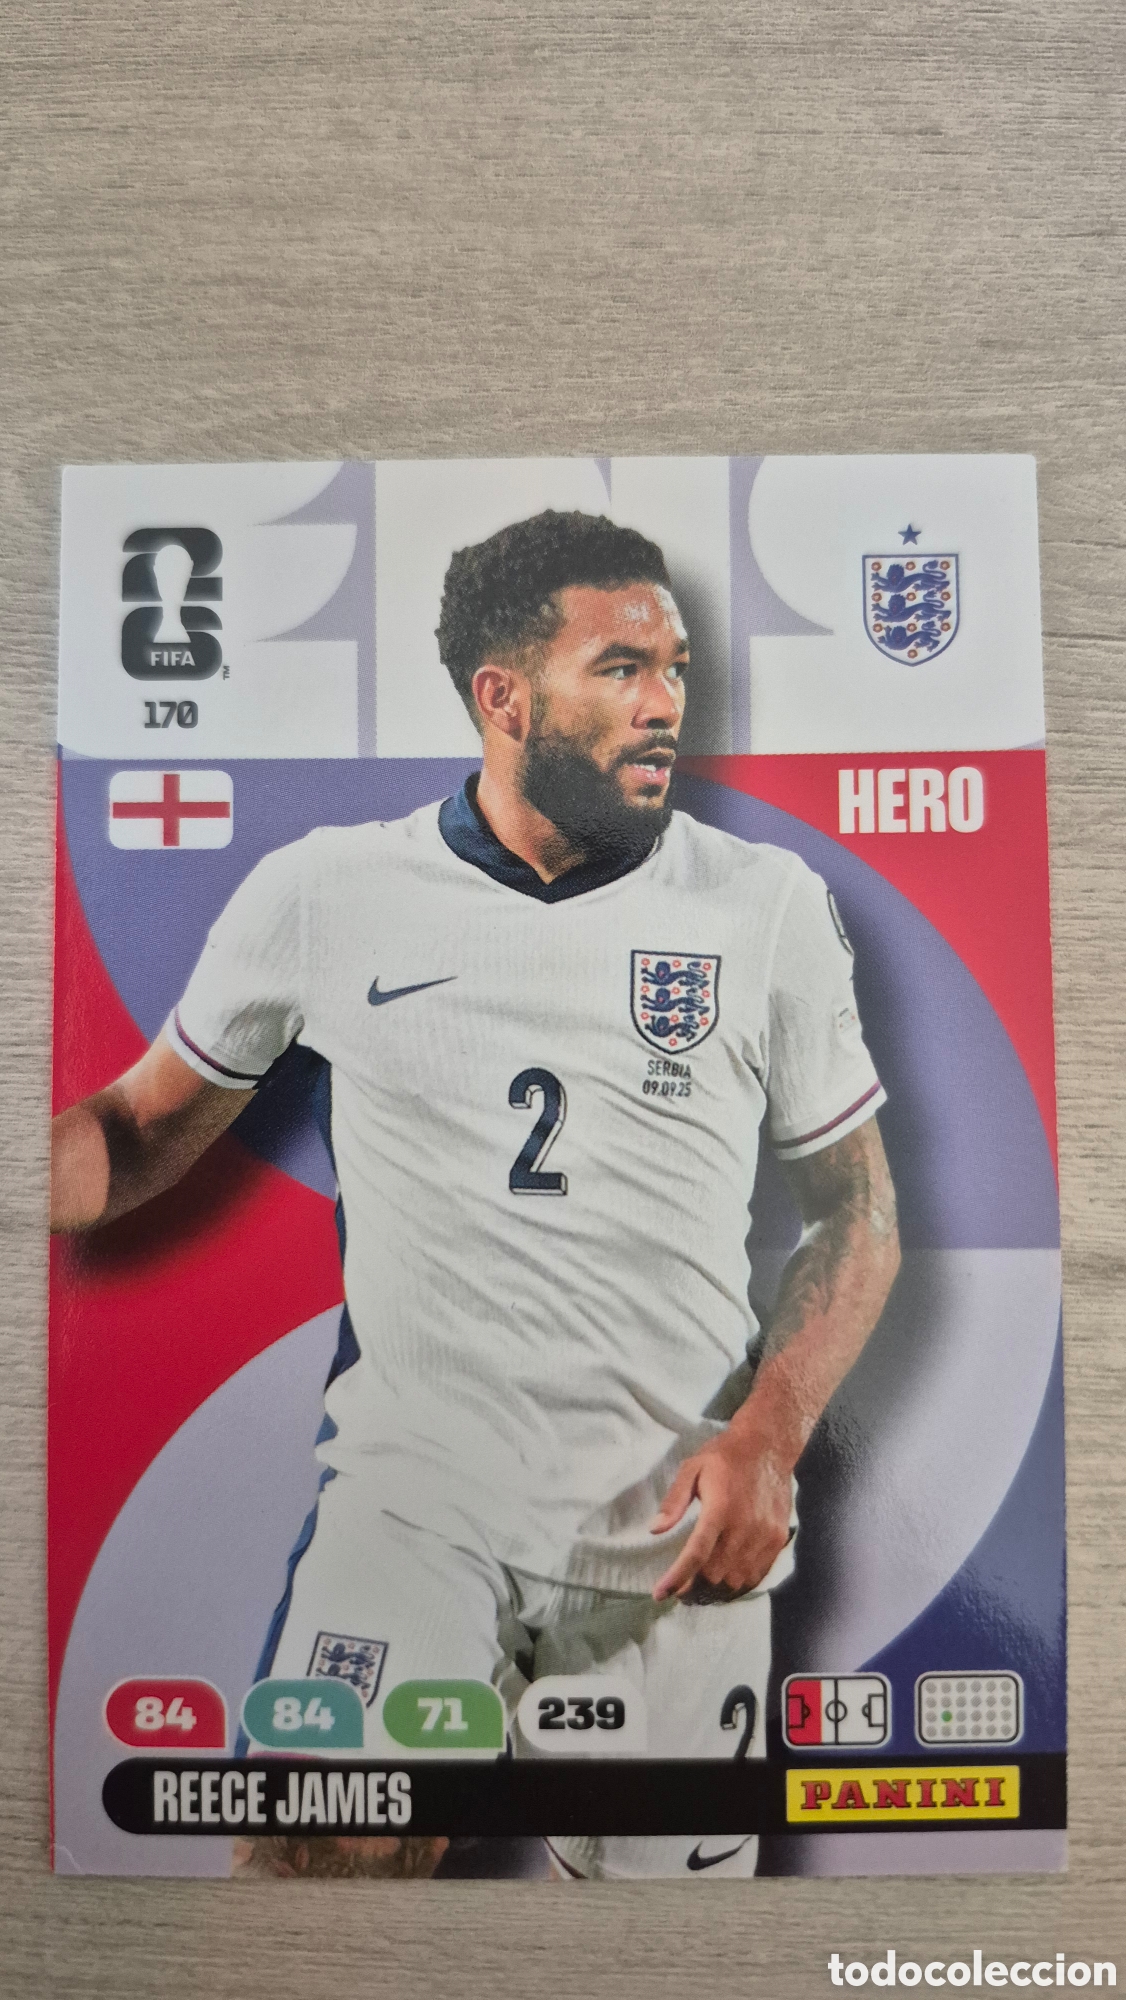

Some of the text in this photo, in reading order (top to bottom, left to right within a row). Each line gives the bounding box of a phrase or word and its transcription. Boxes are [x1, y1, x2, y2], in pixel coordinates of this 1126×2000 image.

[150, 651, 196, 667] FIFA
[144, 700, 199, 729] 170
[838, 766, 985, 835] HERO
[647, 1060, 692, 1079] SERBIA
[642, 1079, 692, 1098] 09.09.25
[508, 1066, 568, 1196] 2
[134, 1696, 198, 1732] 84
[272, 1696, 336, 1732] 84
[417, 1697, 469, 1732] 71
[538, 1696, 626, 1731] 239
[153, 1770, 413, 1826] REECE JAMES
[800, 1777, 1006, 1810] PANINI
